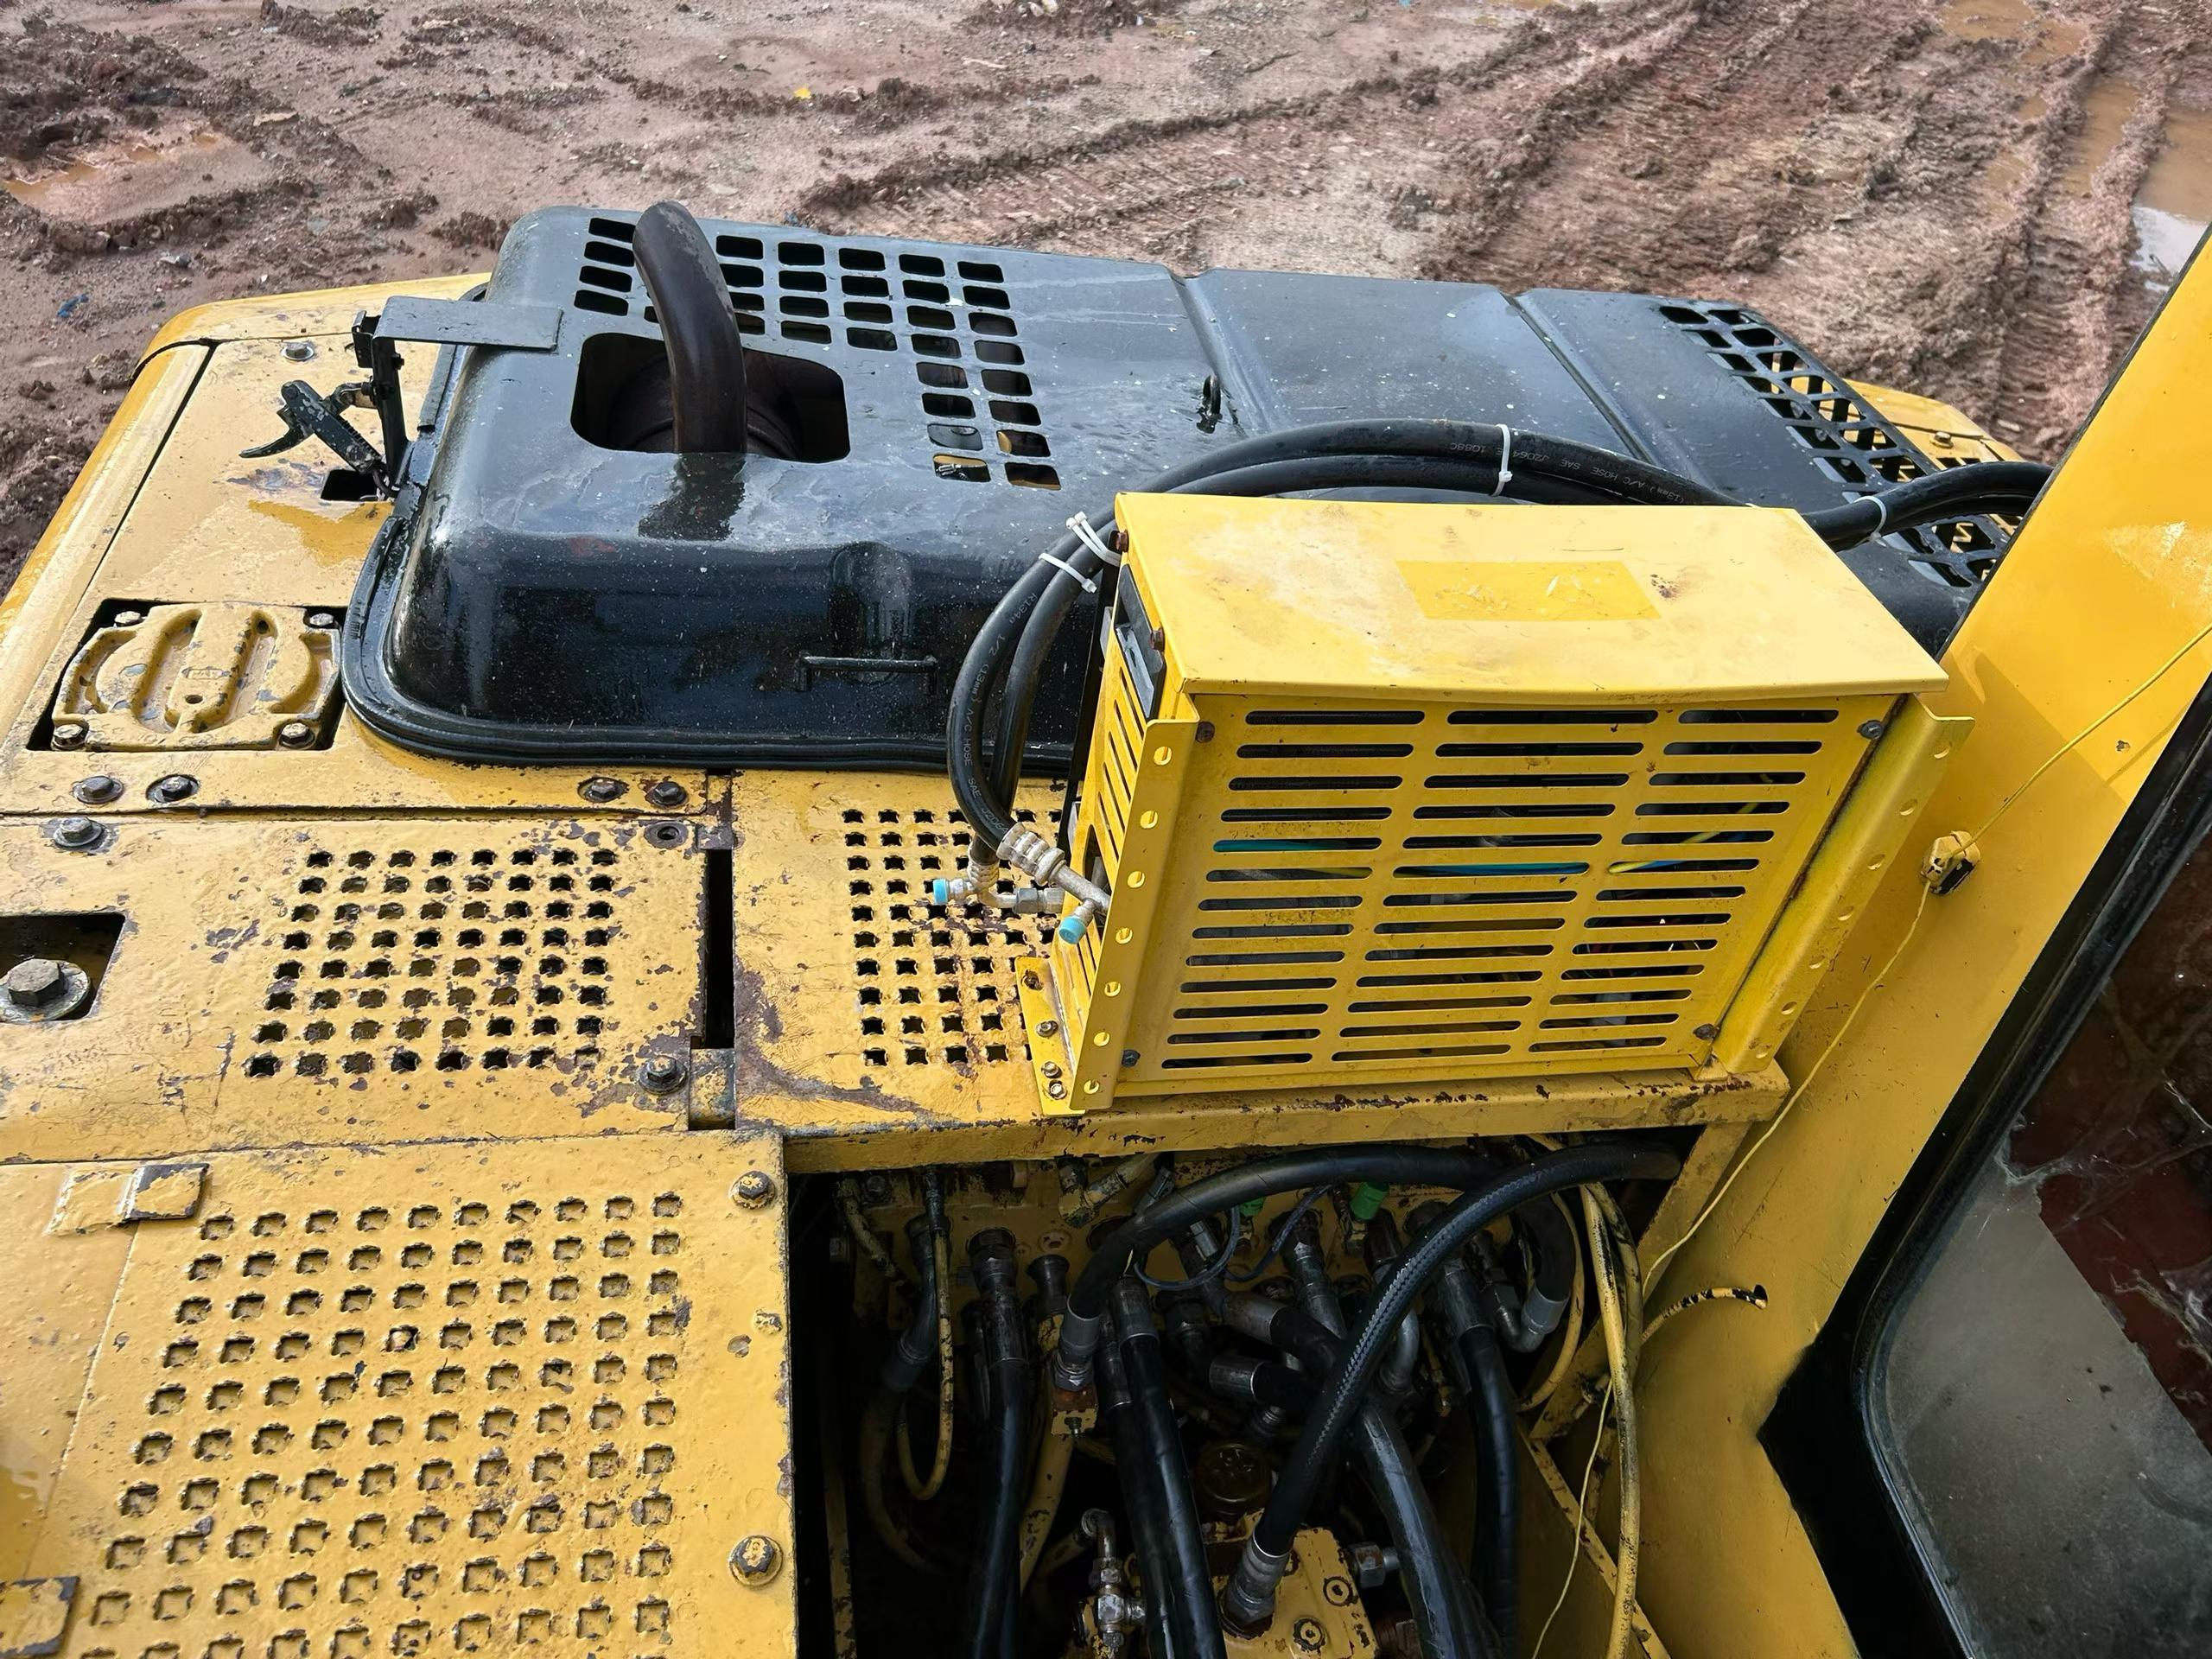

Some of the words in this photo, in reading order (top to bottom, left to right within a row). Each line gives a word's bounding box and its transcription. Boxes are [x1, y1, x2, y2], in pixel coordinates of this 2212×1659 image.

[1512, 450, 1550, 462] J2064
[1560, 458, 1582, 471] SAE
[1591, 467, 1618, 481] HOSE
[1622, 476, 1645, 489] A/C
[988, 633, 1006, 657] 1/2
[963, 707, 974, 733] A/C
[962, 737, 973, 767] HOSE
[967, 777, 982, 799] SAE
